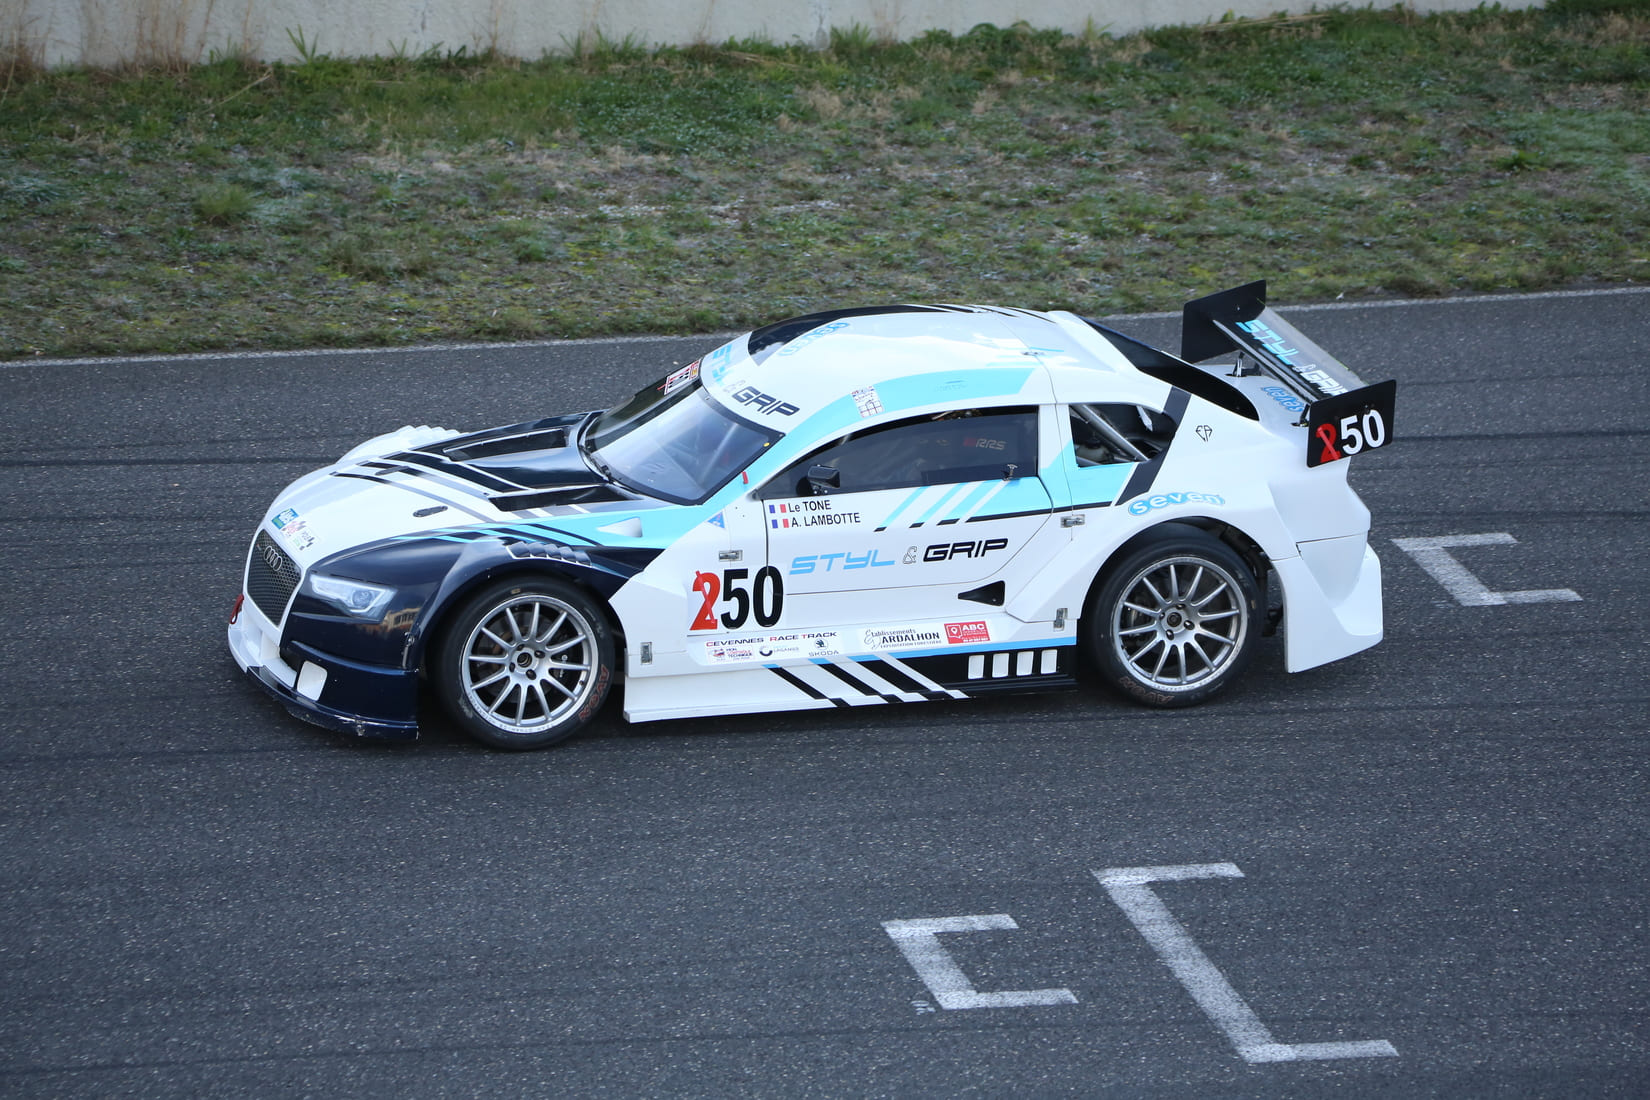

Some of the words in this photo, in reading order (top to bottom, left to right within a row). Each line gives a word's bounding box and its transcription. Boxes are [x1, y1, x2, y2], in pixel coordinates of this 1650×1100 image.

[1235, 319, 1299, 365] STYL
[731, 385, 800, 416] GRIP
[788, 501, 802, 513] Le
[803, 499, 832, 512] TONE
[1129, 492, 1225, 515] seven
[791, 515, 803, 528] A.
[804, 512, 861, 527] LAMBOTTE
[789, 549, 896, 576] STYL
[902, 545, 918, 565] &
[922, 538, 1009, 563] GRIP
[961, 623, 985, 631] ABC
[706, 637, 764, 647] CEVENNES
[769, 634, 799, 642] RACE
[801, 631, 837, 639] TRACK
[881, 632, 940, 645] ARDALHON
